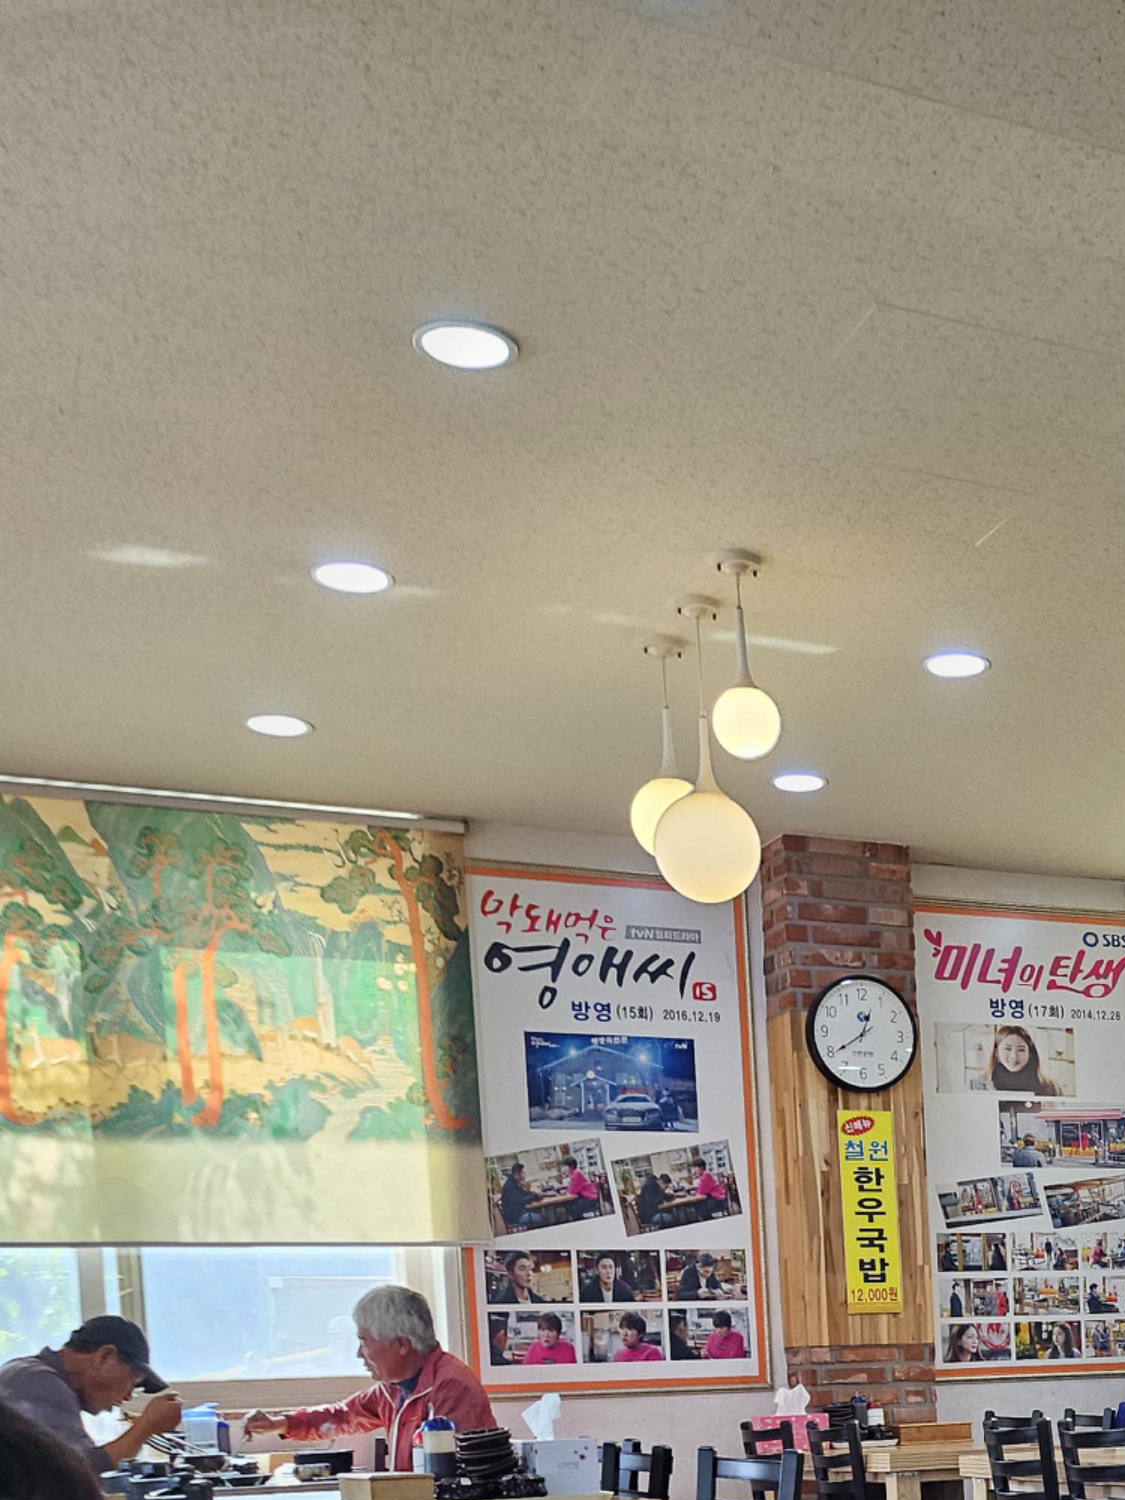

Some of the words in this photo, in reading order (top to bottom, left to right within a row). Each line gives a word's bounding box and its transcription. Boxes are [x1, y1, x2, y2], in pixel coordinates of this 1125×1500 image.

[480, 889, 616, 943] 막돼먹은
[484, 937, 696, 1009] 영애씨
[934, 943, 1044, 993] 미녀의
[839, 993, 849, 1006] 11
[856, 988, 868, 1001] 12
[878, 996, 883, 1008] 1
[571, 1001, 611, 1022] 방영
[616, 1005, 654, 1021] (15회)
[662, 1009, 721, 1023] 2016.12.19
[825, 1005, 838, 1018] 10
[989, 998, 1024, 1019] 방영
[1028, 1004, 1065, 1019] (17회)
[1070, 1009, 1121, 1021] 2014.12.28
[890, 1010, 897, 1023] 2
[820, 1024, 829, 1038] 9
[896, 1030, 904, 1043] 3
[826, 1045, 835, 1058] 8
[890, 1051, 898, 1062] 4
[859, 1068, 867, 1080] 6
[877, 1063, 885, 1076] 5
[845, 1140, 888, 1161] 철원
[853, 1167, 889, 1283] 한우국밥
[851, 1287, 898, 1301] 12,000원
